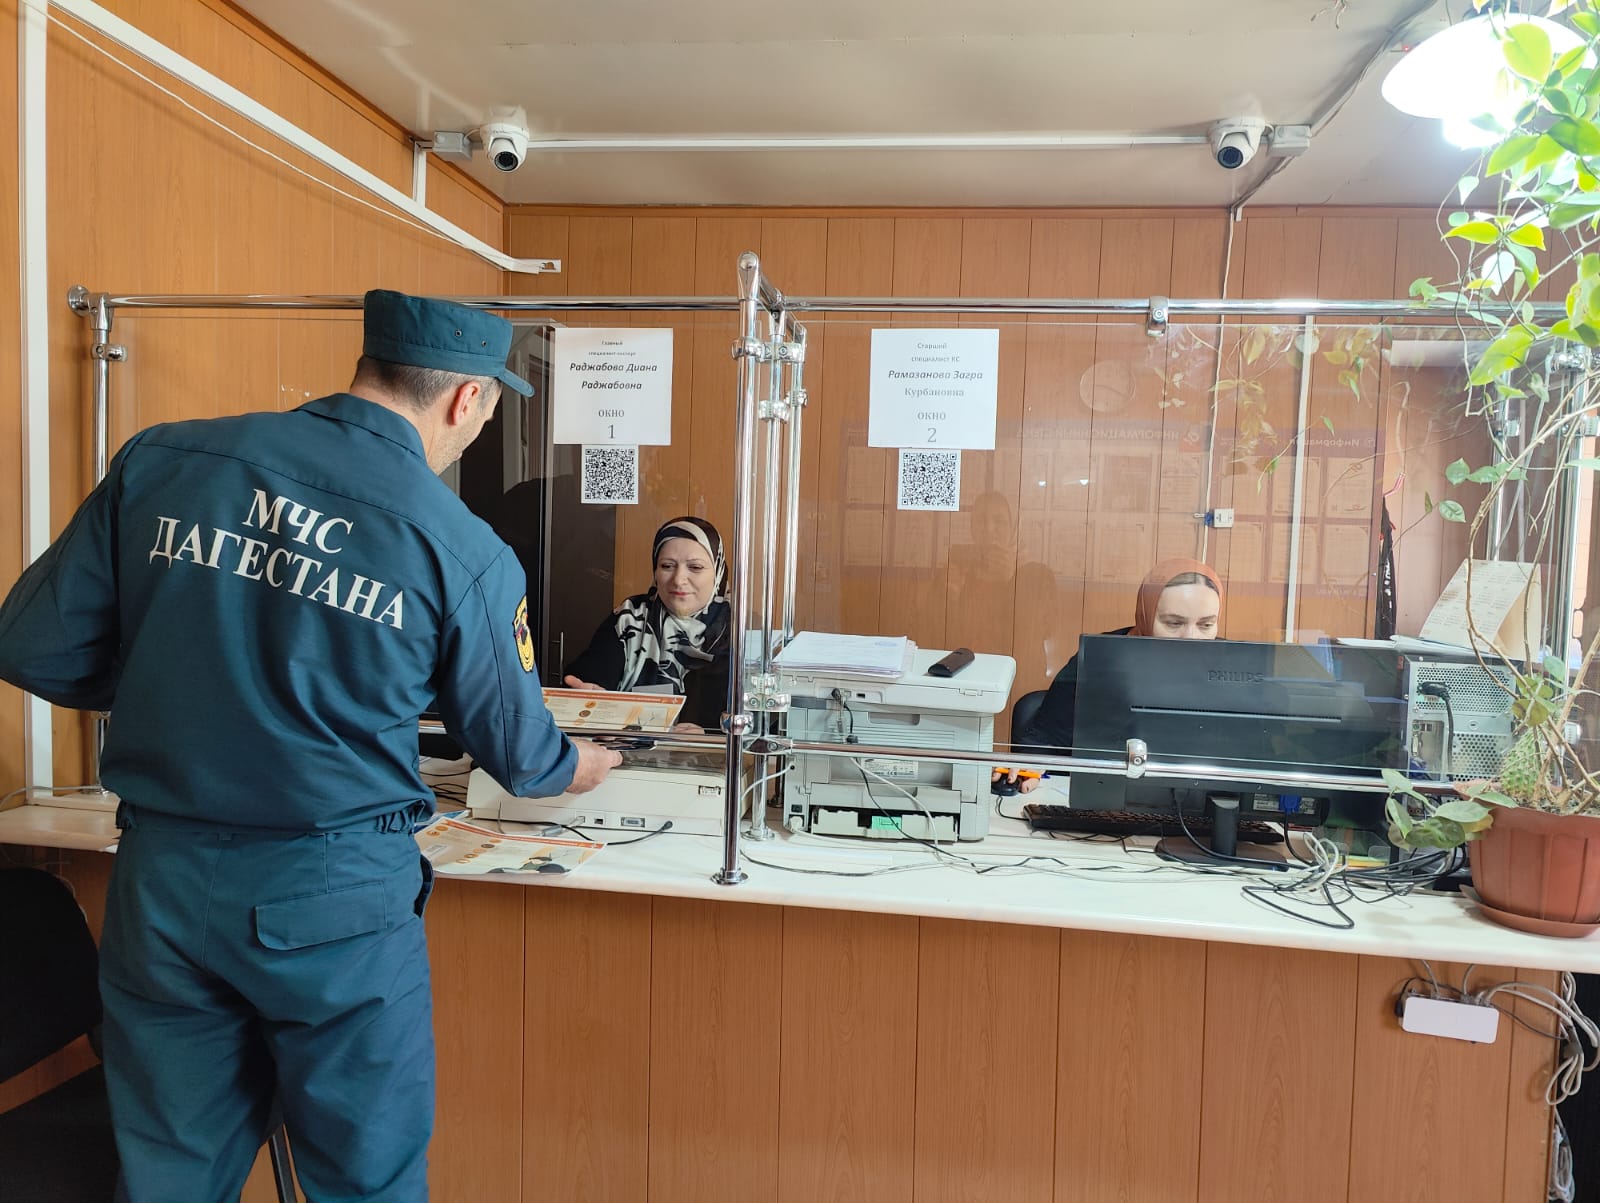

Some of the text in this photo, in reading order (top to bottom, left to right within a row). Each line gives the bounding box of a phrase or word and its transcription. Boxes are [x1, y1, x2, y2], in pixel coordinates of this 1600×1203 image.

[917, 342, 948, 350] Старший
[569, 362, 658, 373] Раджабова Диана
[888, 370, 983, 380] Рамазанова Загра
[581, 380, 643, 390] Раджабовна
[904, 387, 964, 398] Курбановна
[598, 409, 625, 418] ОКНО
[917, 411, 946, 420] ОКНО
[607, 424, 616, 439] 1
[927, 427, 937, 443] 2
[242, 488, 354, 554] МЧС
[148, 516, 404, 630] ДАГЕСТАНА
[1207, 670, 1265, 684] PHILIPS
